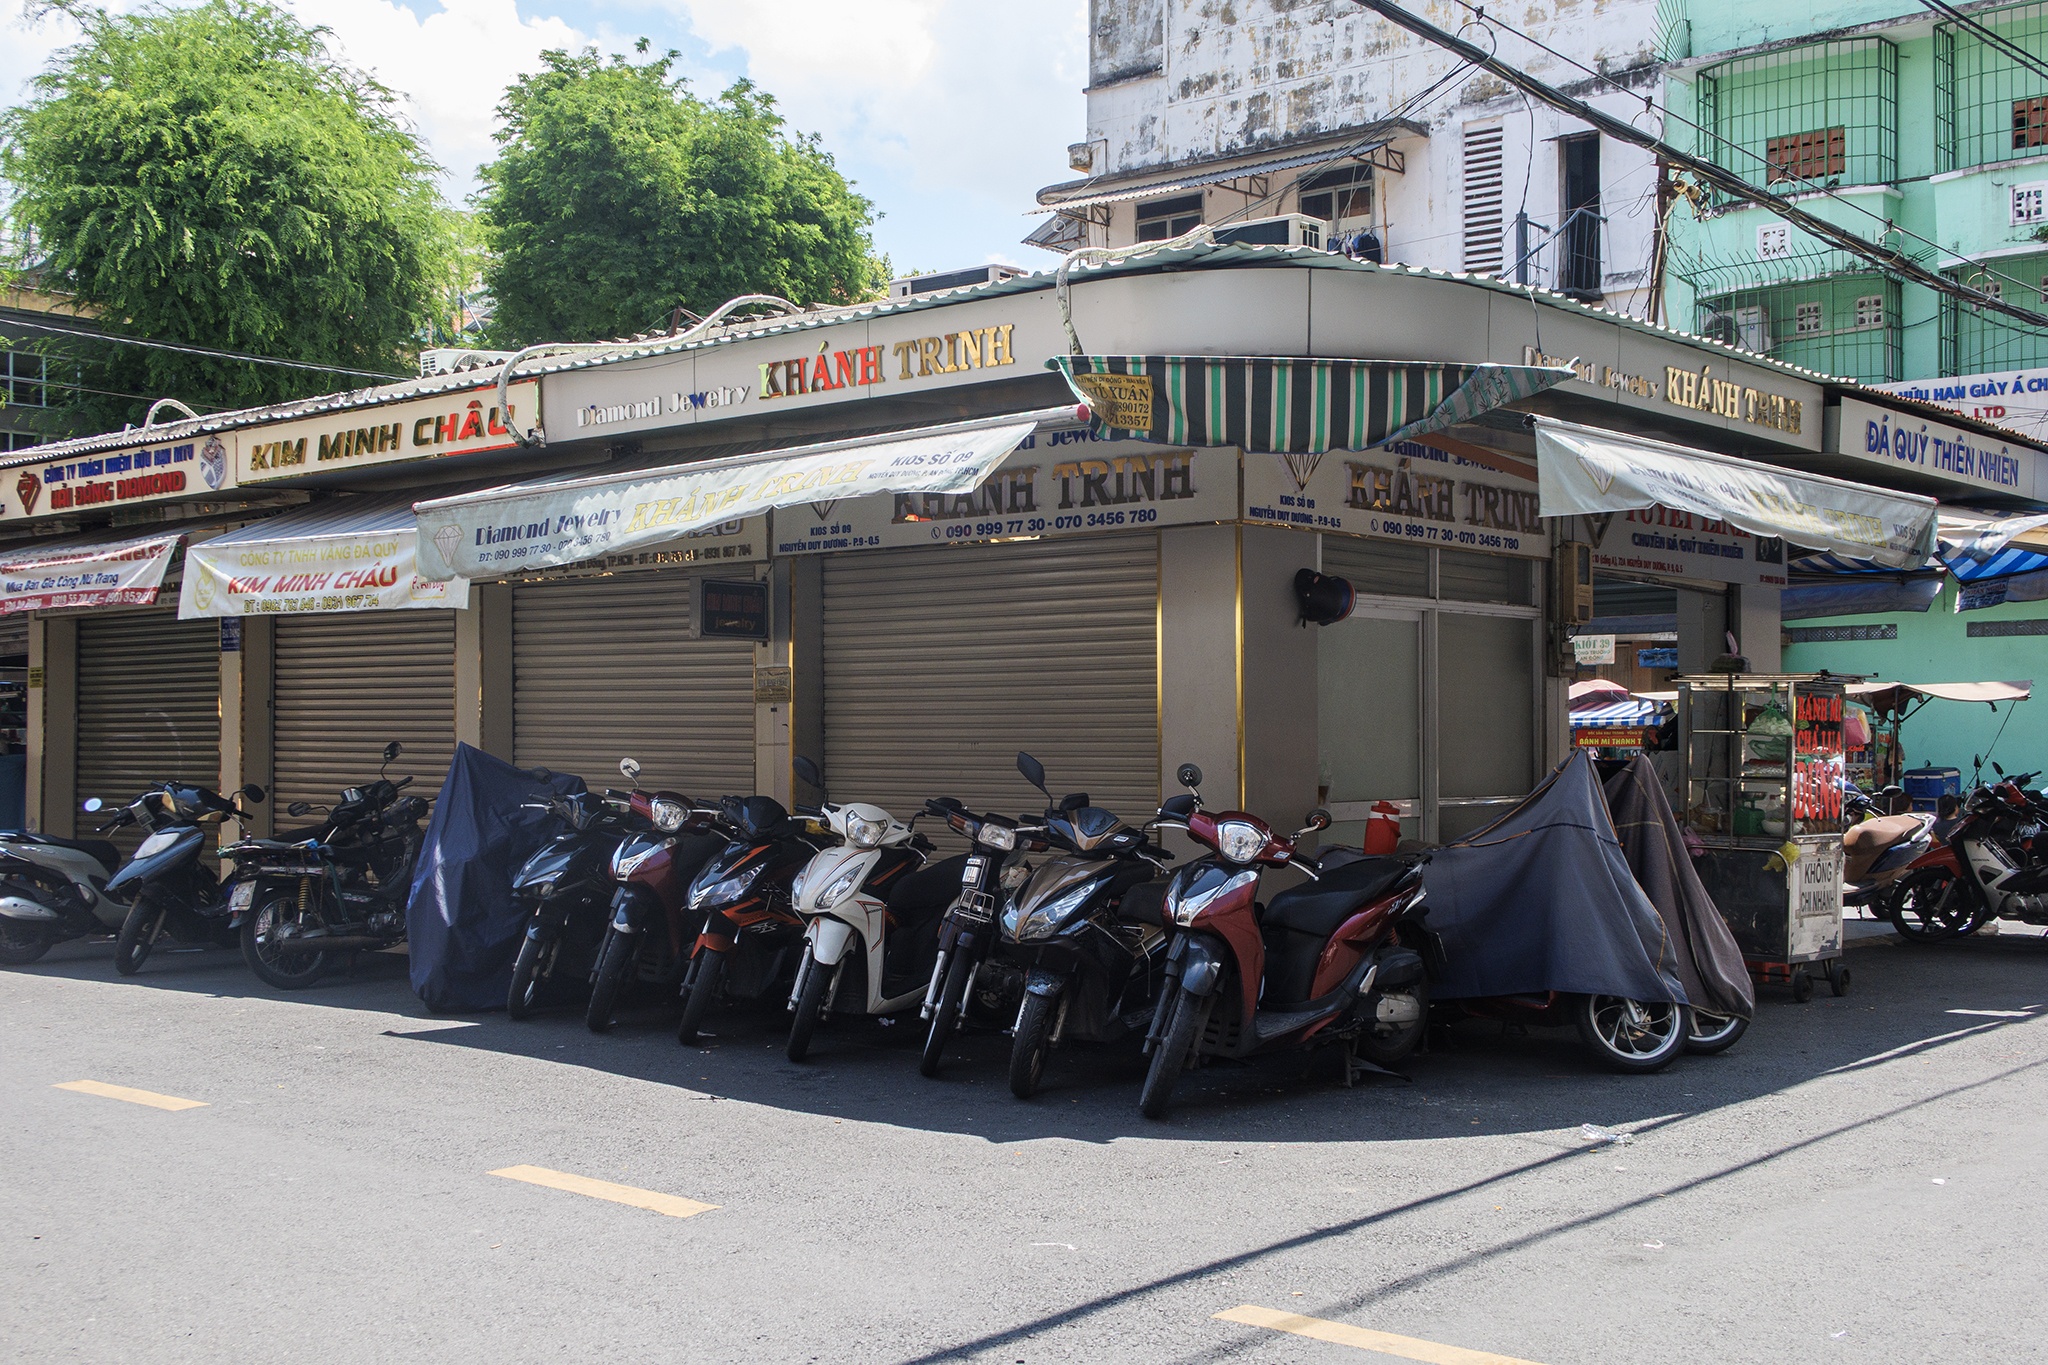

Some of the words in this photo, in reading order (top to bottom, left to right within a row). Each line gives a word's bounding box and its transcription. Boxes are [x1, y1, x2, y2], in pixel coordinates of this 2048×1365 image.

[577, 395, 661, 427] Diamond
[667, 386, 750, 414] Jewelry
[758, 340, 886, 400] KHÁNH
[892, 324, 1016, 381] TRINH
[1934, 385, 1966, 403] HẠN
[1970, 378, 2008, 398] GIÀY
[2011, 375, 2024, 395] Á
[1109, 384, 1149, 402] XUÂN
[1523, 345, 1596, 385] Diamnd
[1599, 365, 1660, 399] Jewelry
[1665, 365, 1741, 419] KHÁNH
[1744, 387, 1803, 435] TRINH
[1974, 405, 2006, 419] LTD
[250, 436, 308, 471] KIM
[317, 422, 402, 461] MINH
[412, 400, 515, 447] CHÂU
[44, 464, 65, 484] CÔNG
[66, 464, 77, 480] TY
[78, 458, 104, 478] TRÁCH
[105, 453, 132, 475] NHIỆM
[174, 443, 194, 463] MTV
[890, 454, 927, 467] KIOS
[928, 449, 958, 466] SỐ
[954, 451, 975, 463] 09
[1865, 413, 1891, 457] ĐÁ
[1893, 424, 1929, 465] QUÝ
[1932, 435, 1975, 477] THIÊN
[1977, 446, 2019, 487] NHIÊN
[51, 482, 74, 510] HẢI
[75, 480, 115, 506] ĐĂNG
[116, 470, 187, 500] DIAMOND
[1052, 450, 1197, 509] TRINH
[624, 485, 750, 535] KHÁNH
[749, 459, 877, 502] TRINH
[1280, 494, 1295, 506] KIOS
[1345, 457, 1456, 523] KHÁNH
[1460, 481, 1546, 536] TRINH
[475, 518, 551, 546] Diamond
[553, 507, 626, 535] Jewelry
[810, 527, 828, 536] KIOS
[830, 521, 840, 535] SỐ
[842, 524, 852, 534] 09
[946, 524, 972, 538] 090
[976, 521, 1003, 535] 999
[1007, 520, 1024, 533] 77
[1028, 518, 1046, 531] 30
[1055, 515, 1083, 529] 070
[1087, 511, 1125, 526] 3456
[1129, 508, 1157, 524] 780
[1249, 505, 1276, 519] NGUYỄN
[1277, 510, 1290, 522] DUY
[1291, 511, 1314, 525] DƯƠNG
[1823, 506, 1887, 549] TRINH
[779, 538, 807, 552] NGUYỄN
[808, 540, 822, 550] DUY
[823, 538, 848, 549] DƯƠNG
[1383, 520, 1402, 535] 090
[1406, 524, 1425, 538] 999
[1427, 526, 1439, 540] 77
[1441, 529, 1453, 542] 30
[1459, 532, 1476, 545] 070
[1479, 534, 1501, 548] 3456
[1503, 537, 1519, 550] 780
[1631, 531, 1665, 550] CHUYÊN
[1666, 533, 1679, 551] ĐÁ
[1698, 538, 1720, 556] THIÊN
[240, 549, 270, 567] CÔNG
[273, 551, 287, 564] TY
[288, 549, 317, 563] TNHH
[319, 543, 351, 560] VÀNG
[354, 544, 371, 559] ĐÁ
[373, 539, 399, 557] QUÝ
[479, 552, 493, 563] ĐT:
[494, 550, 510, 561] 090
[512, 547, 528, 559] 999
[529, 546, 541, 557] 77
[540, 543, 552, 554] 30
[6, 582, 23, 593] Mua
[24, 580, 39, 590] Bán
[57, 575, 78, 589] Công
[95, 572, 119, 586] Trang
[228, 575, 272, 595] KIM
[272, 571, 334, 593] MINH
[333, 561, 398, 590] CHÂU
[1600, 639, 1610, 649] 39
[1797, 692, 1828, 722] BÁNH
[1829, 694, 1842, 722] MÌ
[1580, 736, 1599, 745] BÁNH
[1601, 737, 1610, 745] MÌ
[1804, 858, 1832, 884] KHÔNG
[1801, 891, 1812, 912] CHI
